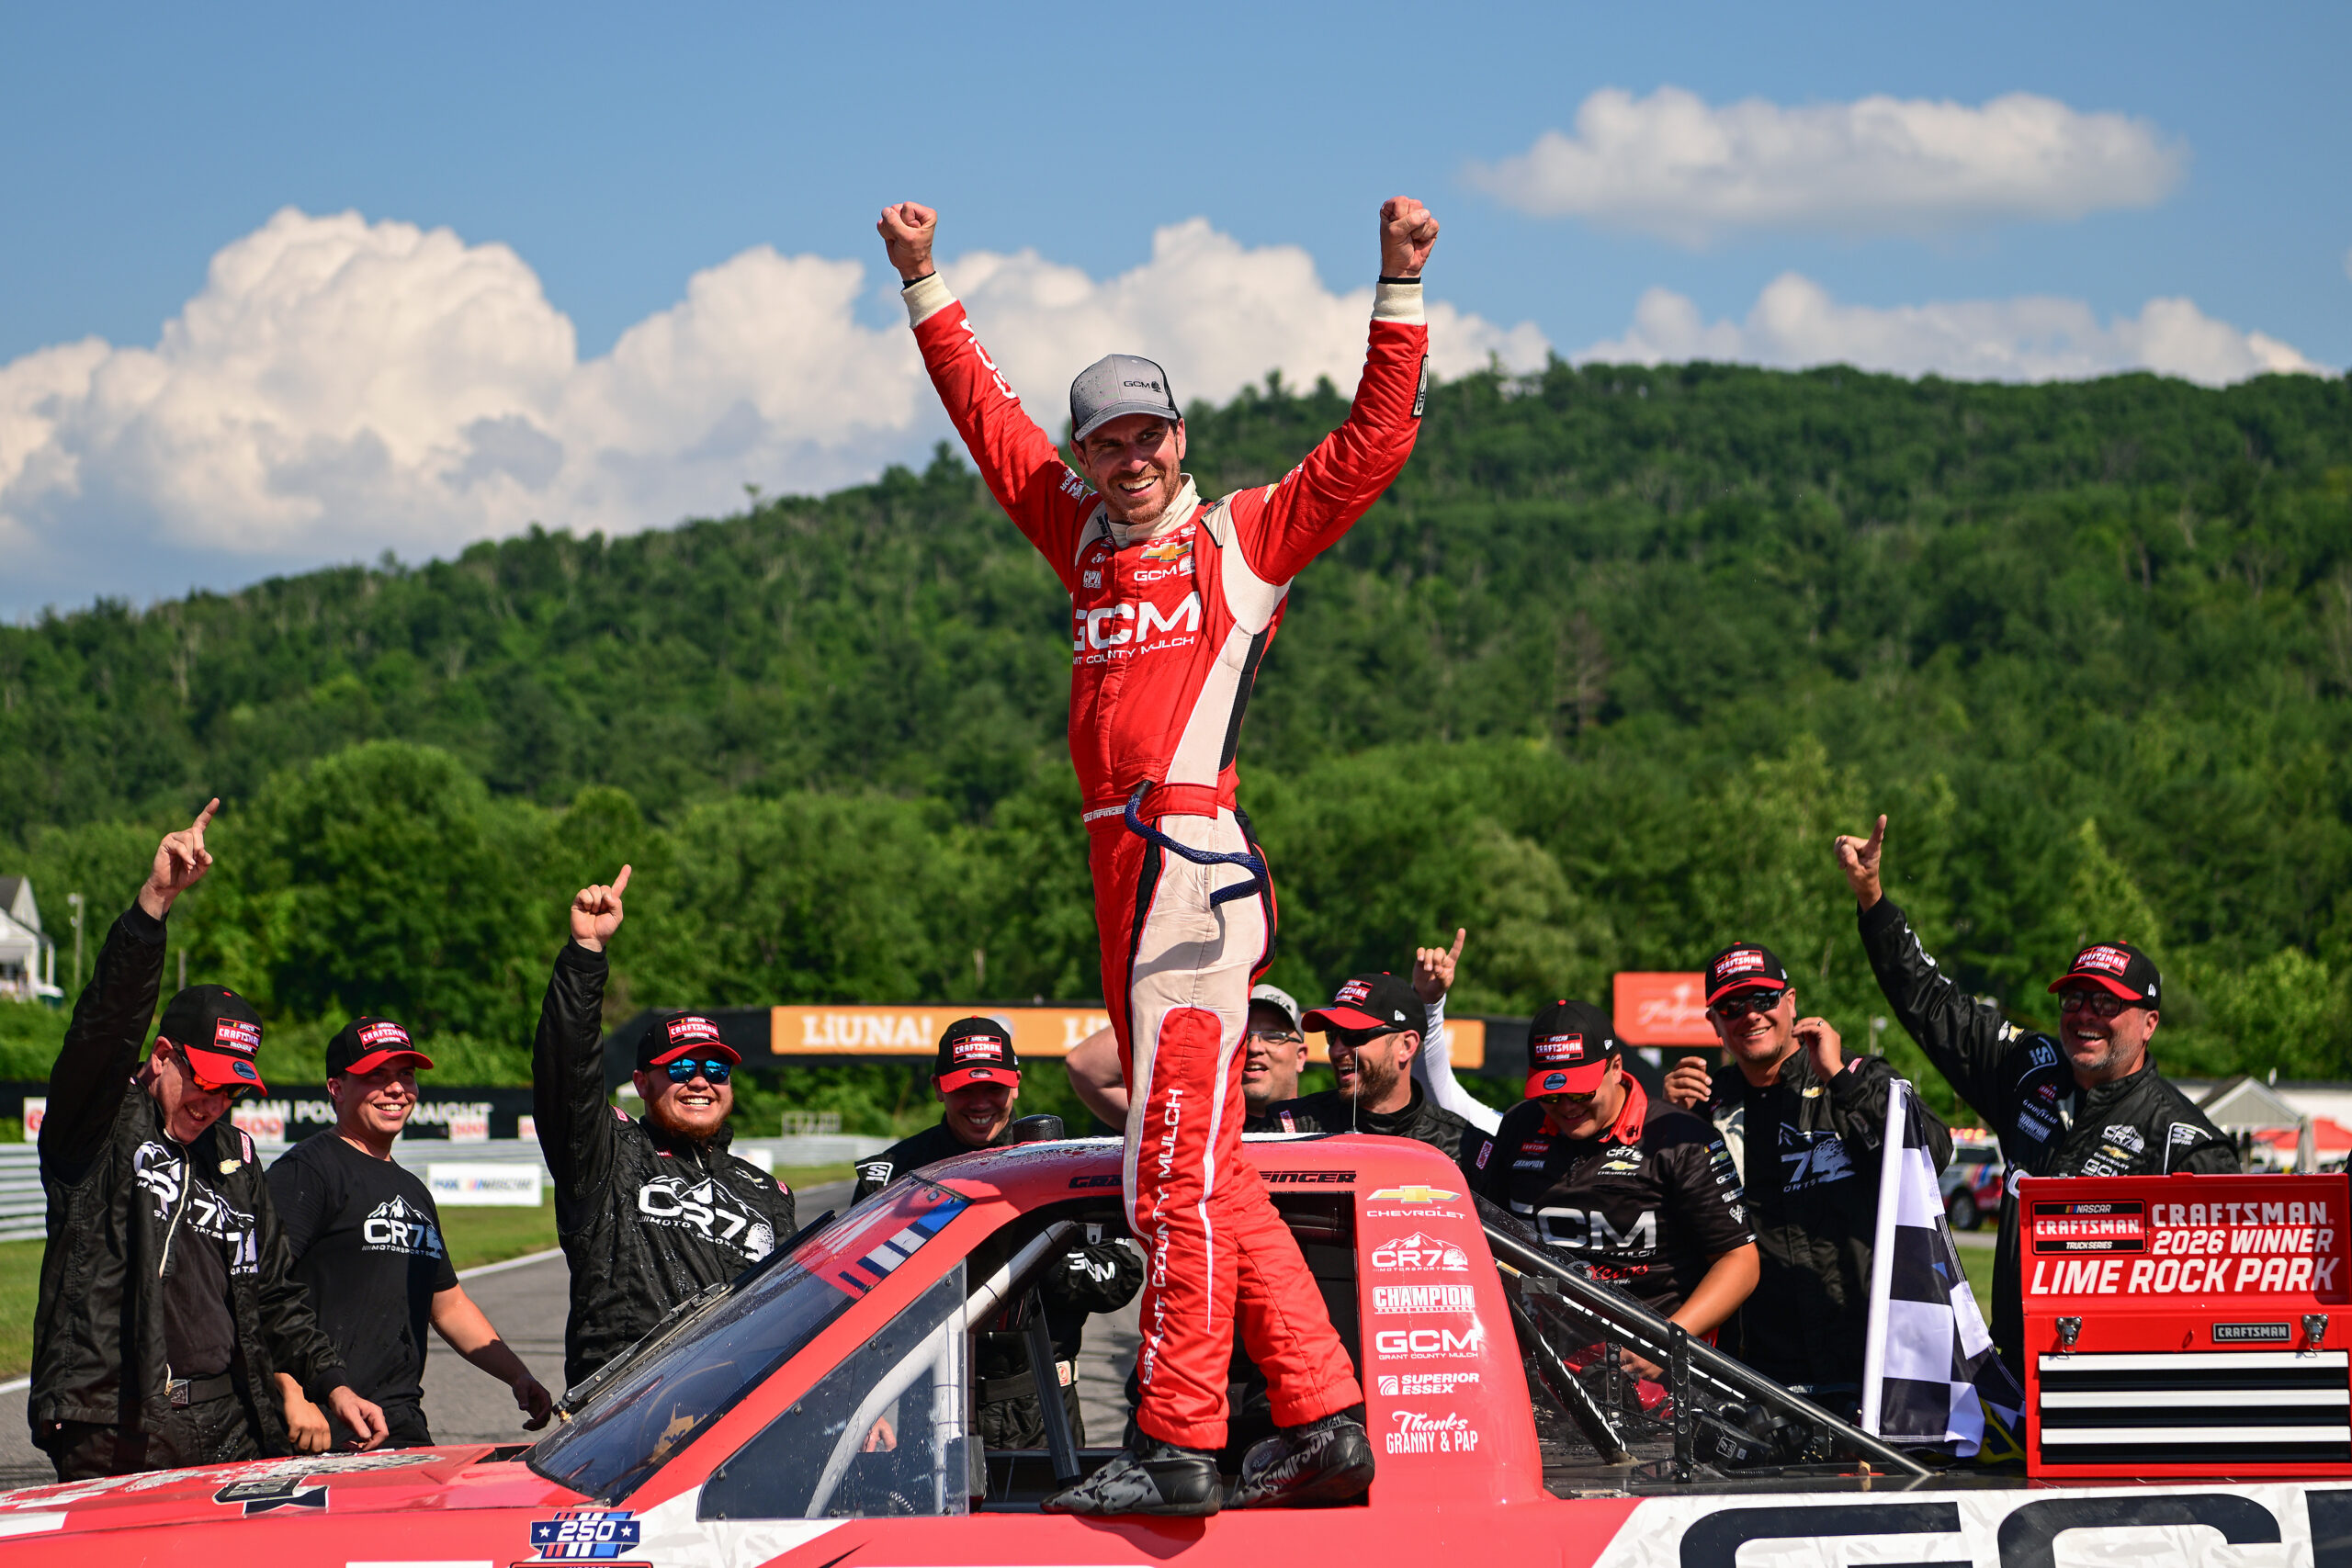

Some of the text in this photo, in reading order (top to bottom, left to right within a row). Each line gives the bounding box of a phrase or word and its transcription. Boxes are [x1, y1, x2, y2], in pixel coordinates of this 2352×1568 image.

[1124, 380, 1151, 389] GCM
[1134, 565, 1178, 581] GCM
[1086, 648, 1136, 664] COUNTY
[1140, 636, 1194, 655] MULCH
[1717, 955, 1763, 974] CRAFTSMAN
[671, 1023, 718, 1035] CRAFTSMAN
[955, 1043, 1001, 1055] CRAFTSMAN
[1535, 1043, 1581, 1054] CRAFTSMAN
[408, 1101, 492, 1125] RAIGHT
[639, 1183, 747, 1241] CR7
[1366, 1209, 1466, 1220] CHEVROLET
[2076, 1203, 2111, 1214] NASCAR
[2152, 1201, 2327, 1228] CRAFTSMAN
[364, 1218, 425, 1248] CR7
[1143, 1088, 1183, 1385] GRANT COUNTY MULCH
[2036, 1219, 2140, 1235] CRAFTSMAN
[2065, 1240, 2113, 1250] TRUCK SERIES
[2152, 1228, 2335, 1256] 2026 WINNER
[1372, 1249, 1443, 1268] CR7
[2030, 1257, 2341, 1295] LIME ROCK PARK
[1374, 1287, 1473, 1307] CHAMPION
[1375, 1328, 1478, 1354] GCM
[2217, 1326, 2288, 1338] CRAFTSMAN
[1401, 1372, 1480, 1385] SUPERIOR
[1402, 1383, 1454, 1395] ESSEX
[1392, 1410, 1469, 1436] Thanks
[1385, 1429, 1479, 1455] GRANNY & PAP
[1263, 1429, 1336, 1493] SIMPSON
[556, 1520, 616, 1542] 250
